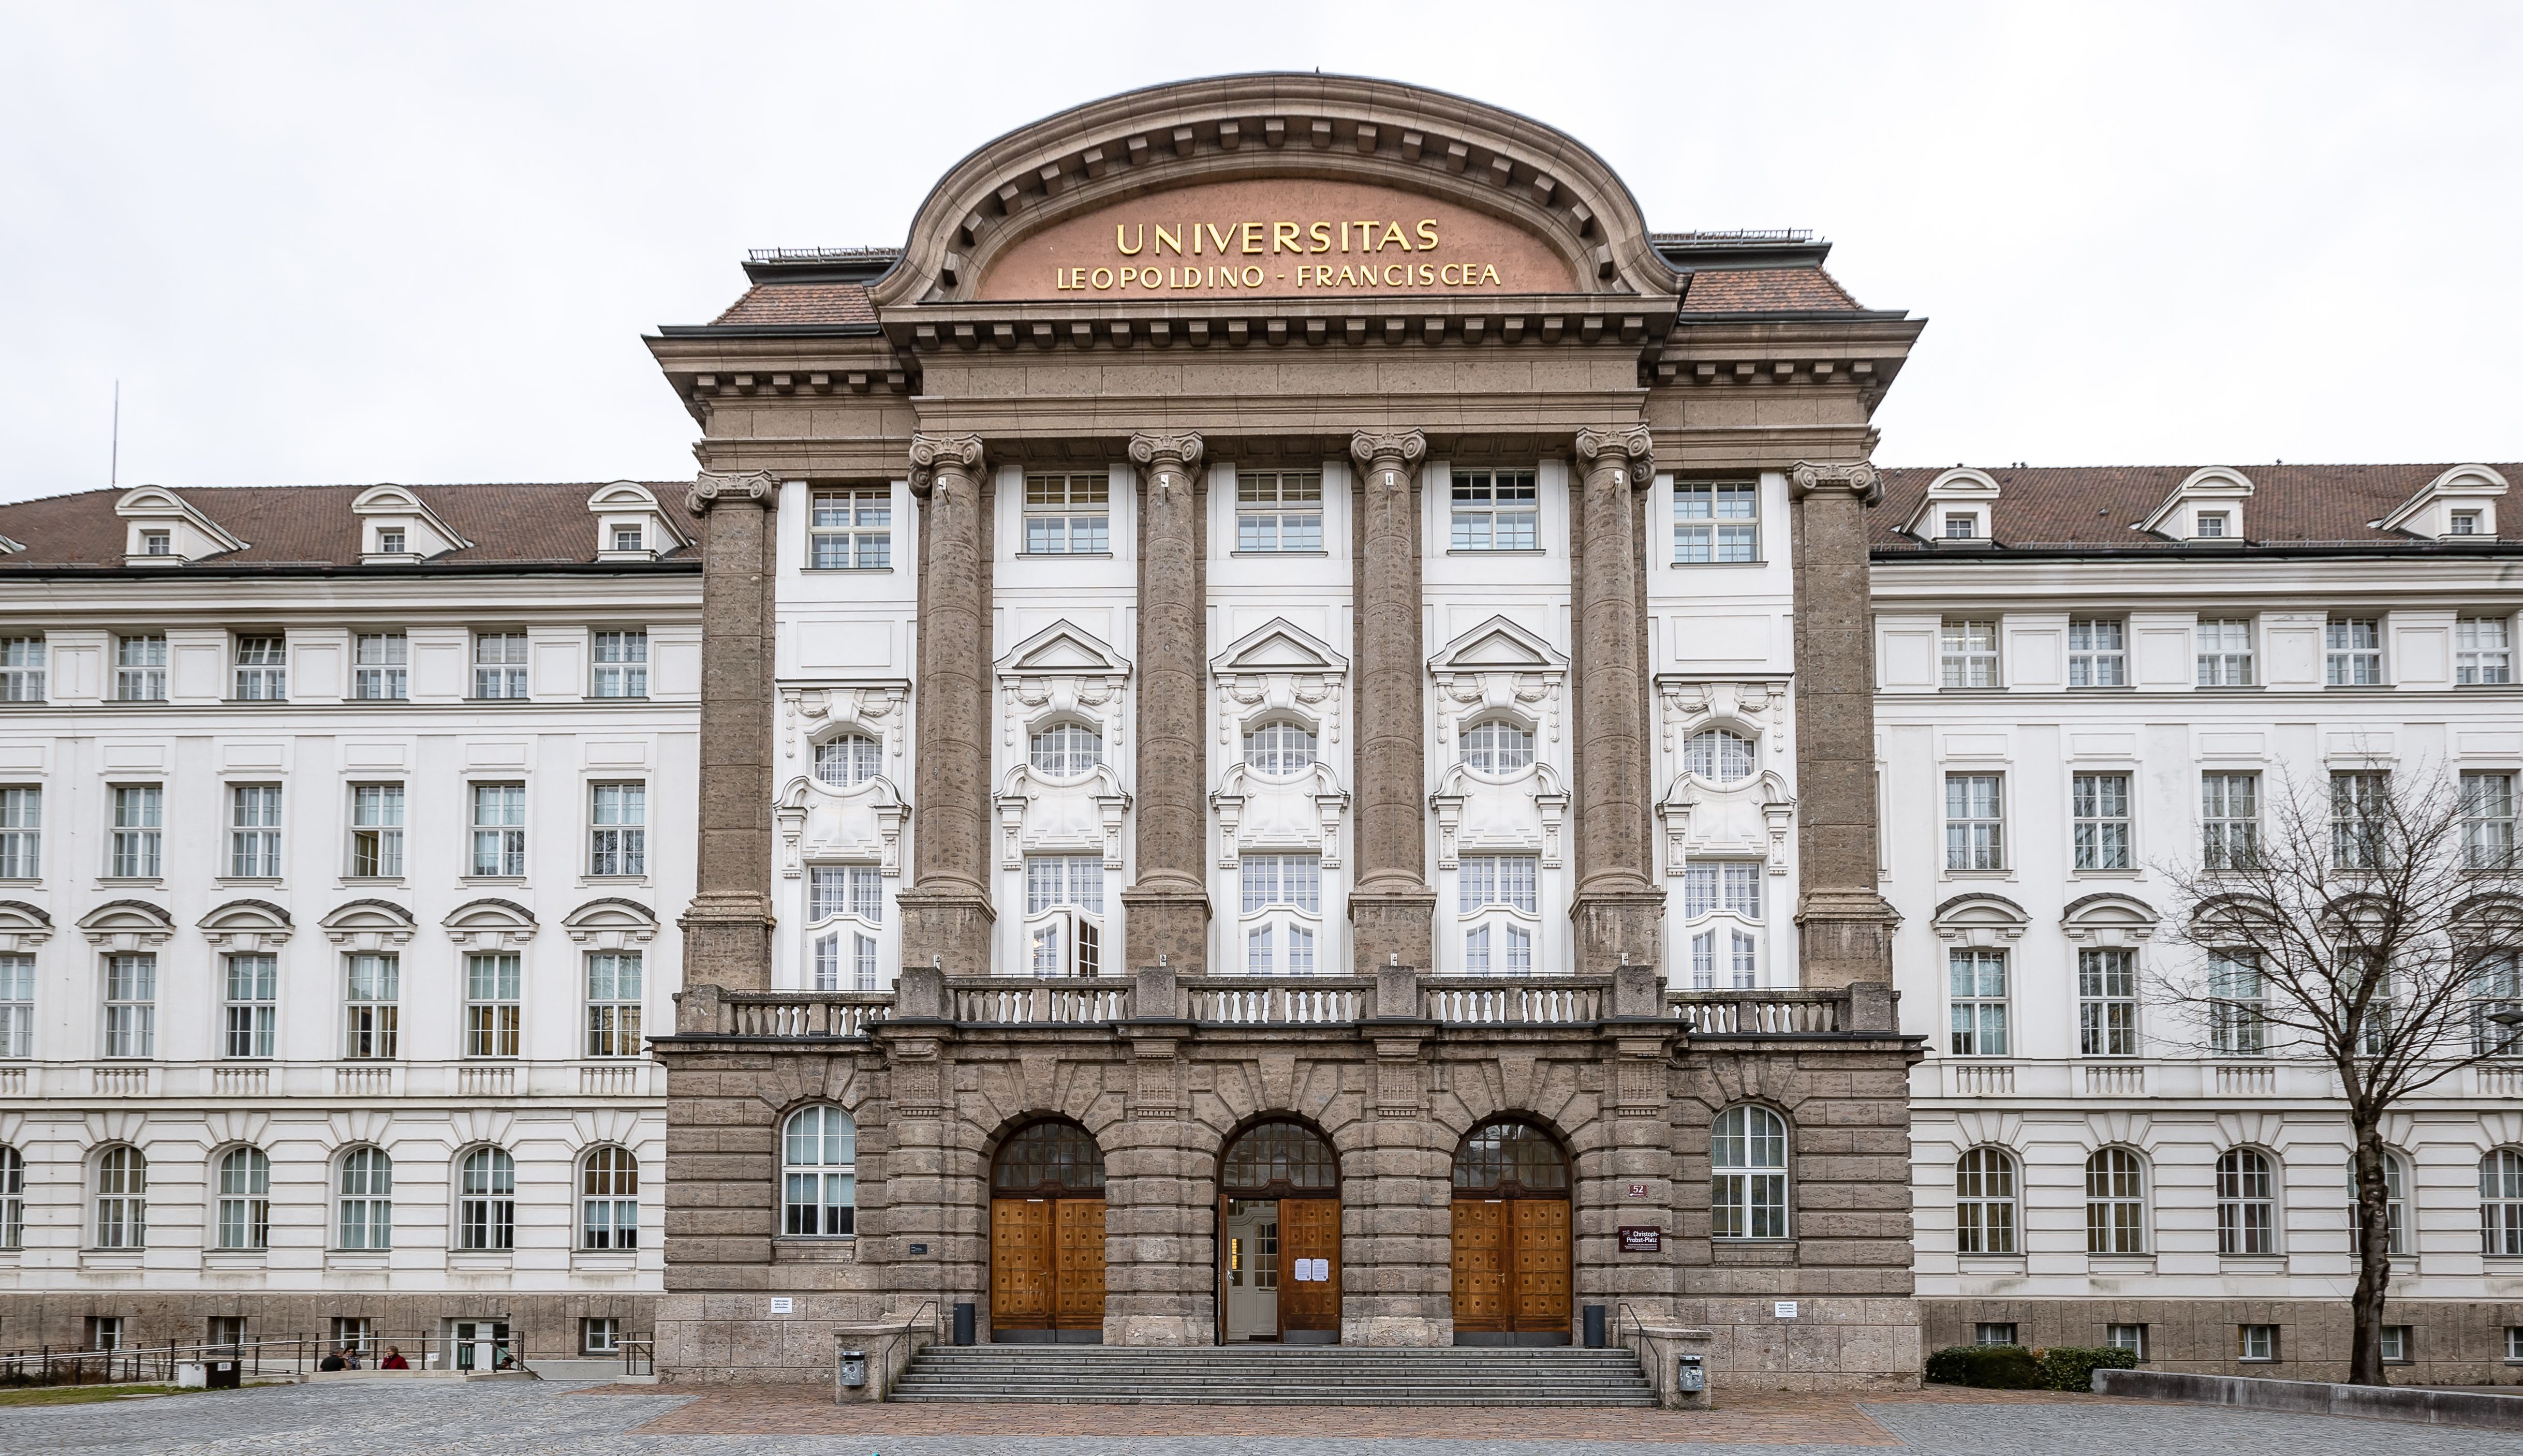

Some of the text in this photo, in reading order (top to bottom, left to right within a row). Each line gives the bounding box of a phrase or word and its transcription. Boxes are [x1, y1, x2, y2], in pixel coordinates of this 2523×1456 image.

[1116, 218, 1439, 256] UNIVERSITAS
[1057, 265, 1265, 290] LEOPOLDINO
[1297, 263, 1501, 288] FRANCISCEA
